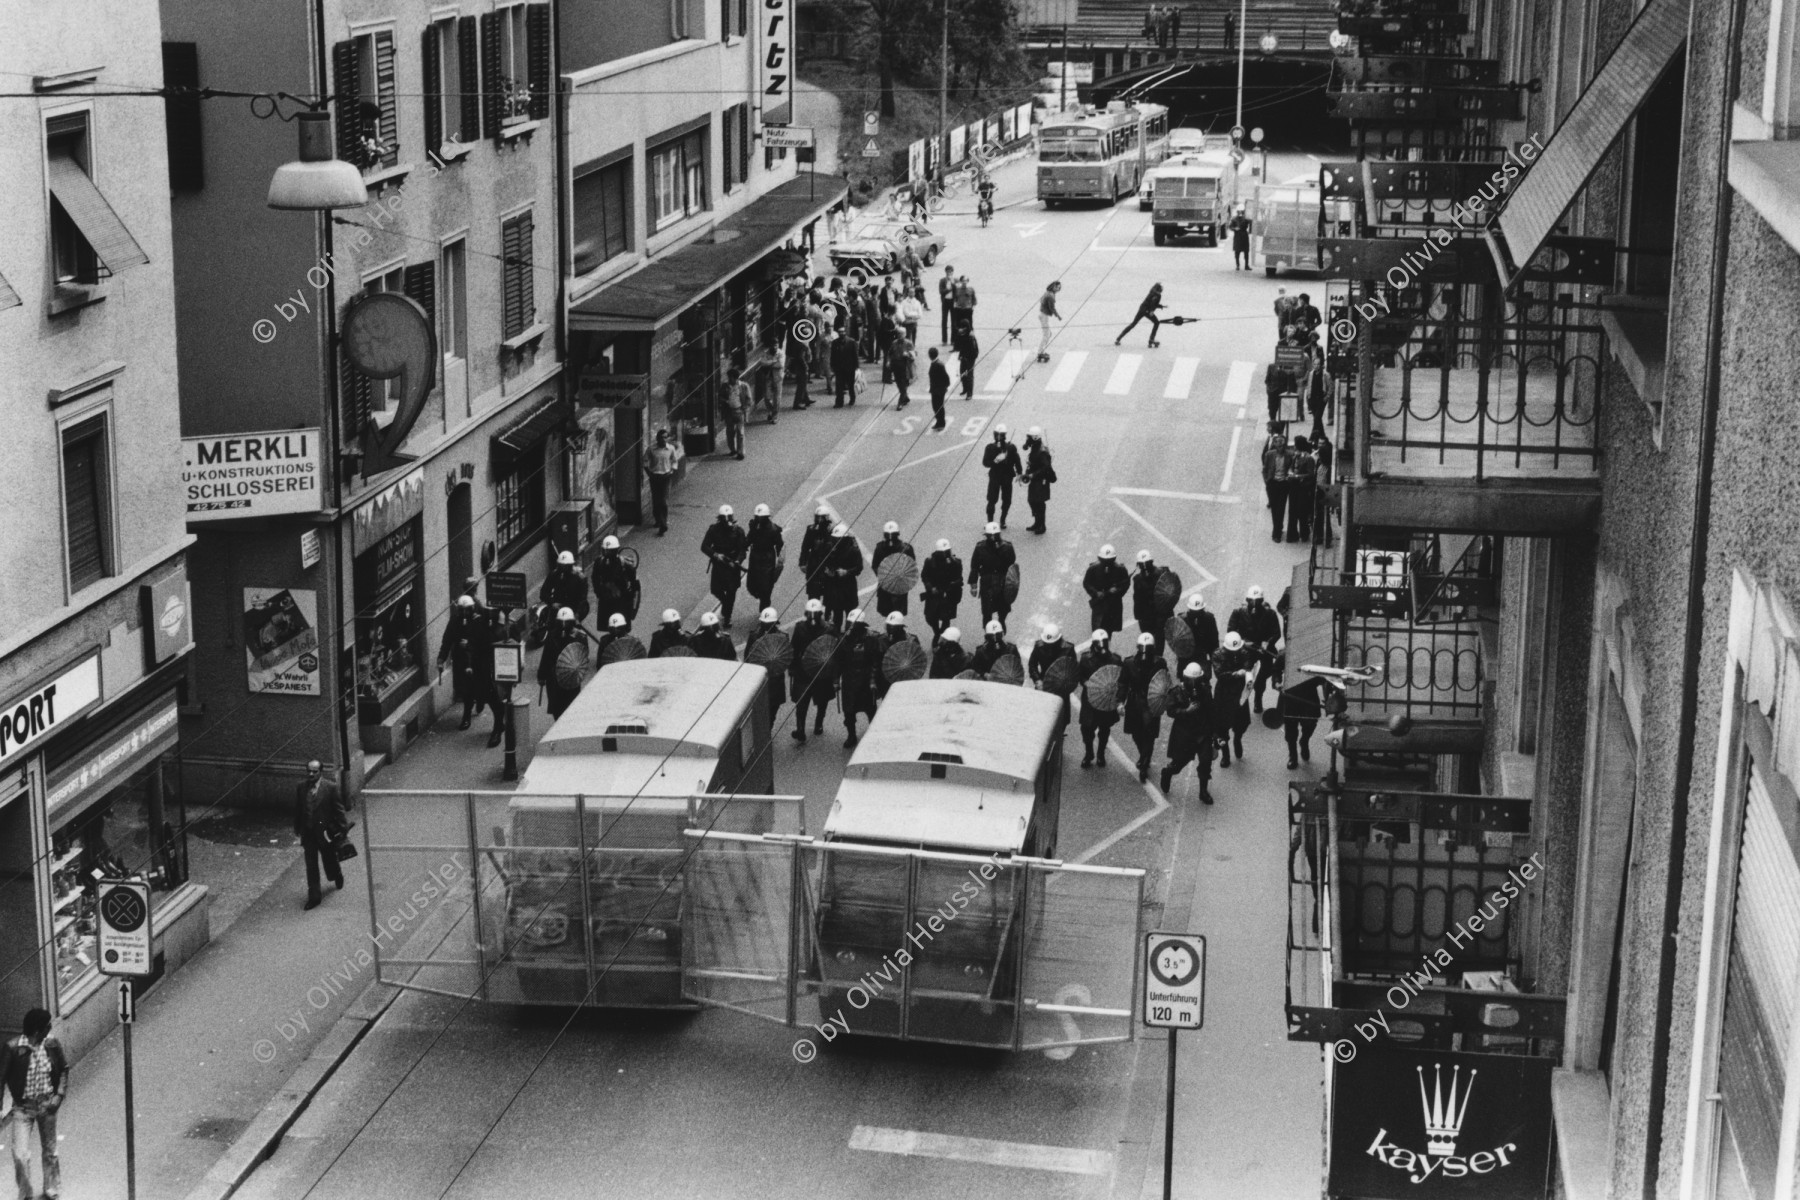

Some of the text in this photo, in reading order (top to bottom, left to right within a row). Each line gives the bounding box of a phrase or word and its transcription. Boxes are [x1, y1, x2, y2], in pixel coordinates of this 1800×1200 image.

[766, 129, 788, 137] Nutz-
[766, 138, 808, 148] Fahrzeuge
[198, 435, 307, 465] MERKLI
[187, 476, 315, 499] SCHLOSSEREI
[377, 540, 414, 582] FILM-SHOW
[263, 682, 313, 692] VESPANEST
[0, 684, 56, 757] PORT
[1149, 992, 1198, 1006] Unterführung
[1152, 1006, 1192, 1023] 120 m
[1366, 1128, 1517, 1184] kayser
